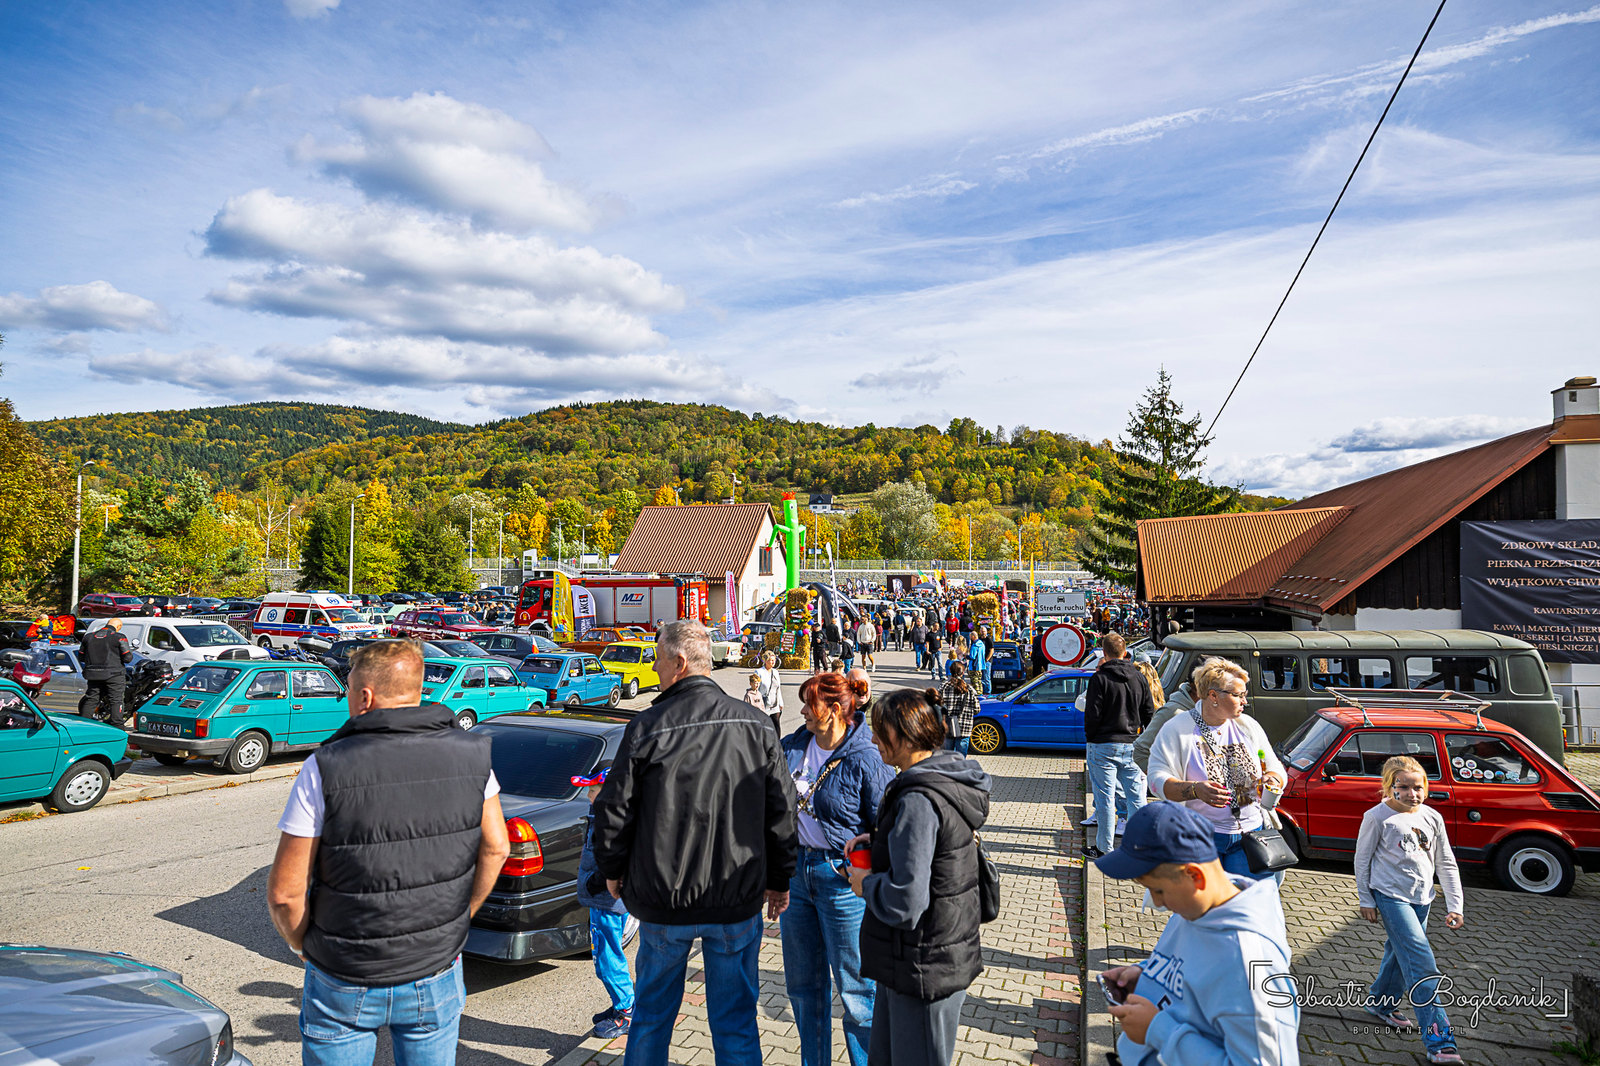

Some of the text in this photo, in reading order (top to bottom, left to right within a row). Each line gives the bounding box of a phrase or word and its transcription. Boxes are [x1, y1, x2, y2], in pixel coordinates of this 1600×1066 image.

[1501, 541, 1555, 550] ZDROWY
[1487, 577, 1565, 588] WYJĄTKOWA
[1039, 604, 1061, 612] Strefa
[1533, 607, 1590, 615] KAWIARNIA
[1493, 624, 1521, 632] KAWA
[1528, 625, 1571, 633] MATCHA
[1513, 634, 1554, 642] DESERKI
[1534, 643, 1594, 652] MIEŚLNICZE
